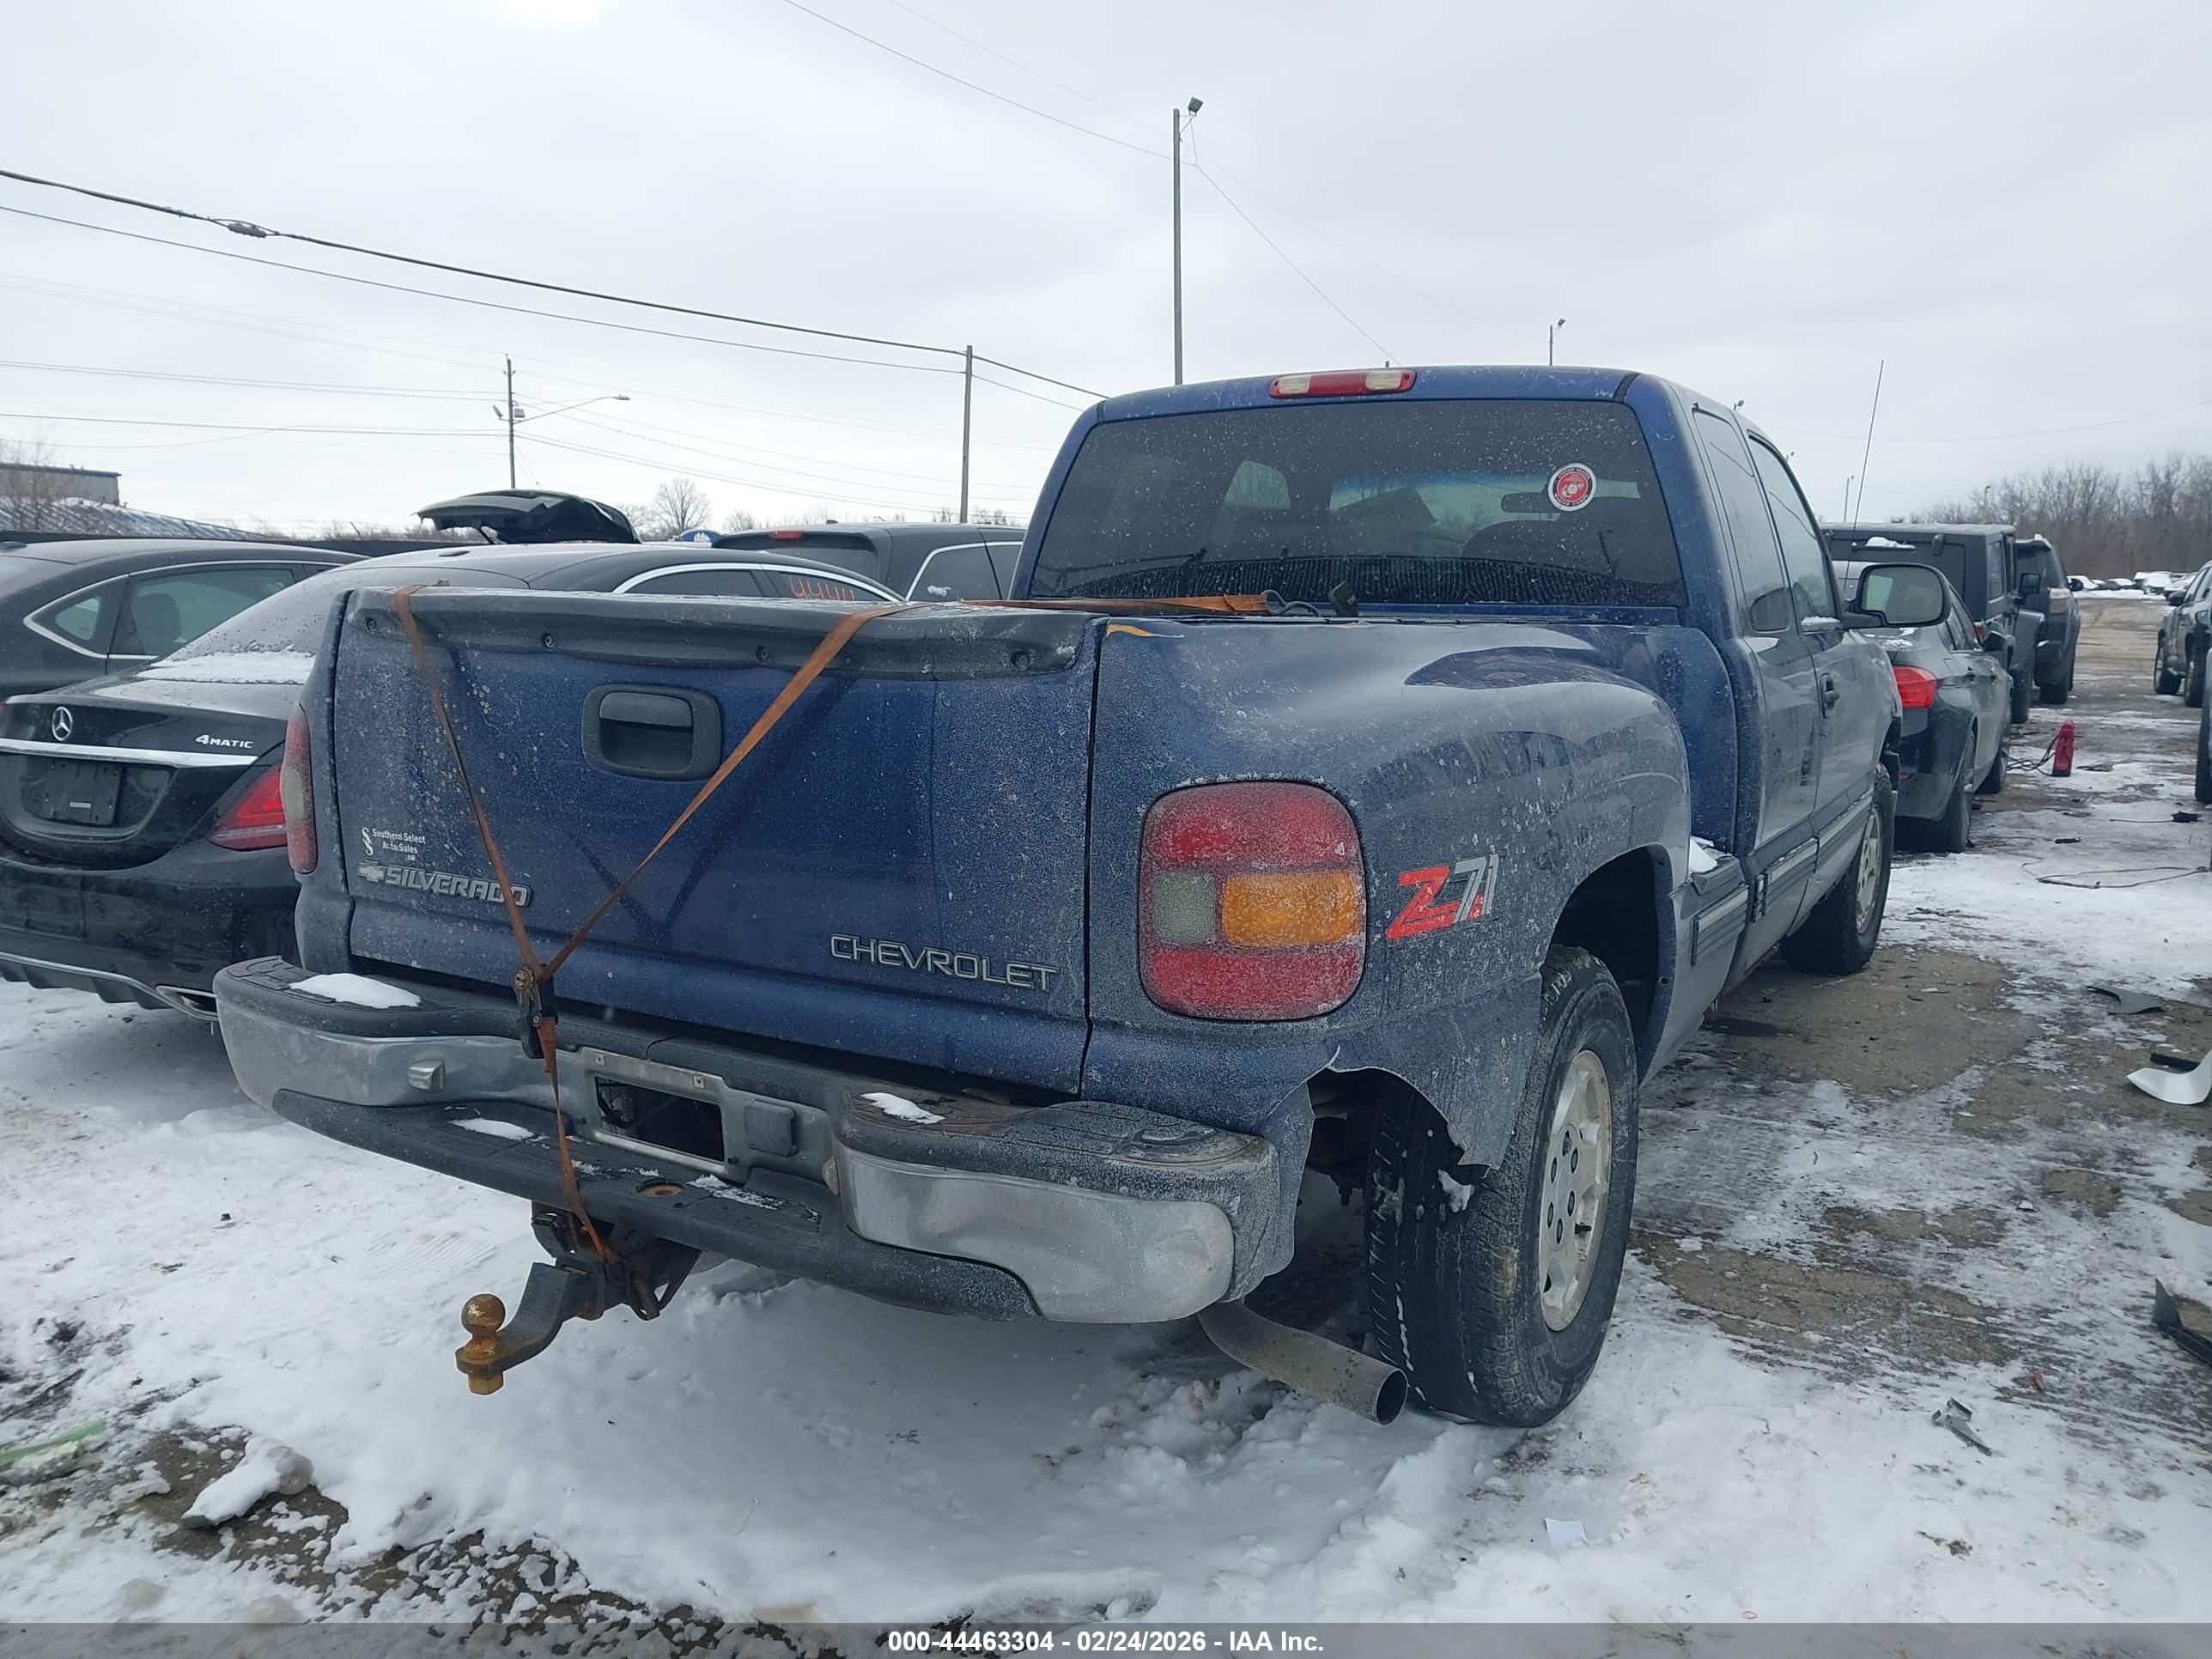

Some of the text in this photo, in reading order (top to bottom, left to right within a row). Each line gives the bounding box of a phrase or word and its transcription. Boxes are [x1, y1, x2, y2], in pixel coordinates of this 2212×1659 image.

[195, 734, 254, 749] 4MATIC
[372, 828, 426, 844] Southern Select
[398, 842, 417, 854] Sales
[385, 865, 529, 907] SILVERADO
[1384, 854, 1499, 940] Z71
[830, 933, 1059, 991] CHEVROLET
